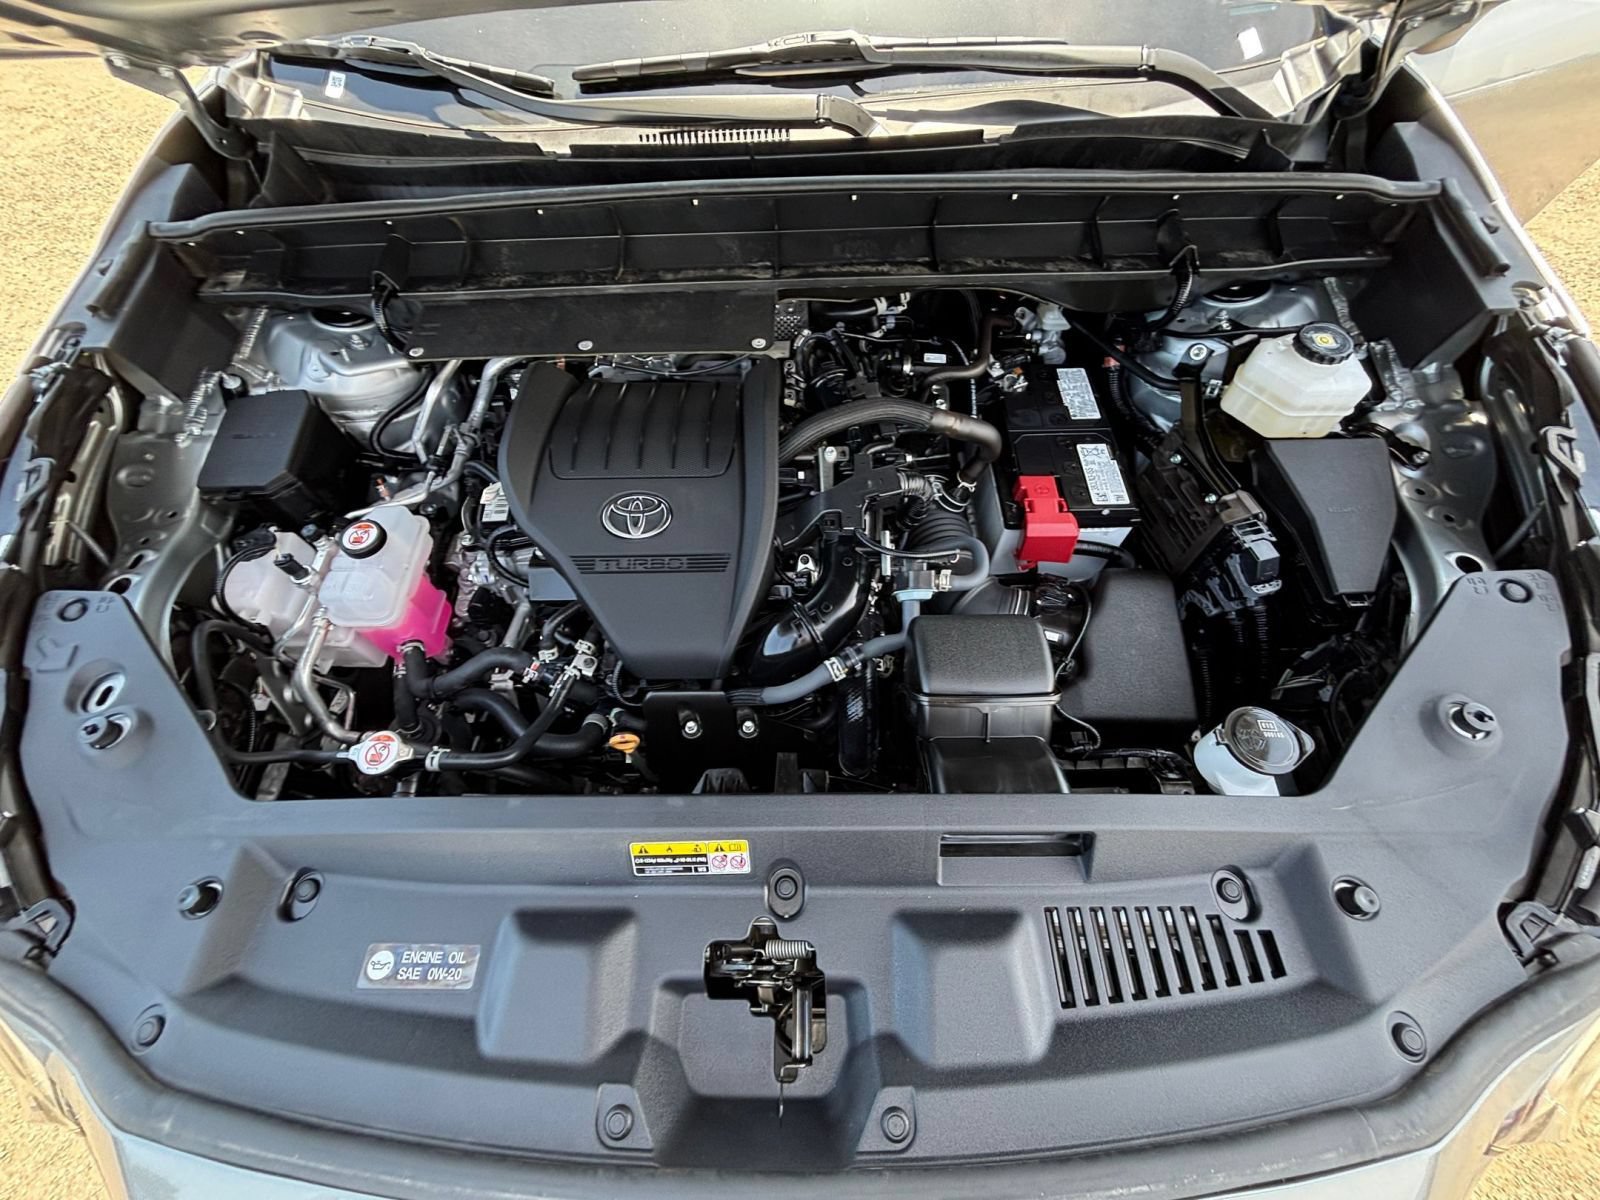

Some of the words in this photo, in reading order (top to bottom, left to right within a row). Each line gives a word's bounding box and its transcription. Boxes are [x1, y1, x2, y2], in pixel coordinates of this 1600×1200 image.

[598, 558, 684, 570] TURBO
[401, 951, 443, 964] ENGINE
[447, 951, 466, 964] OIL
[397, 967, 421, 980] SAE
[427, 968, 462, 981] 0W-20
